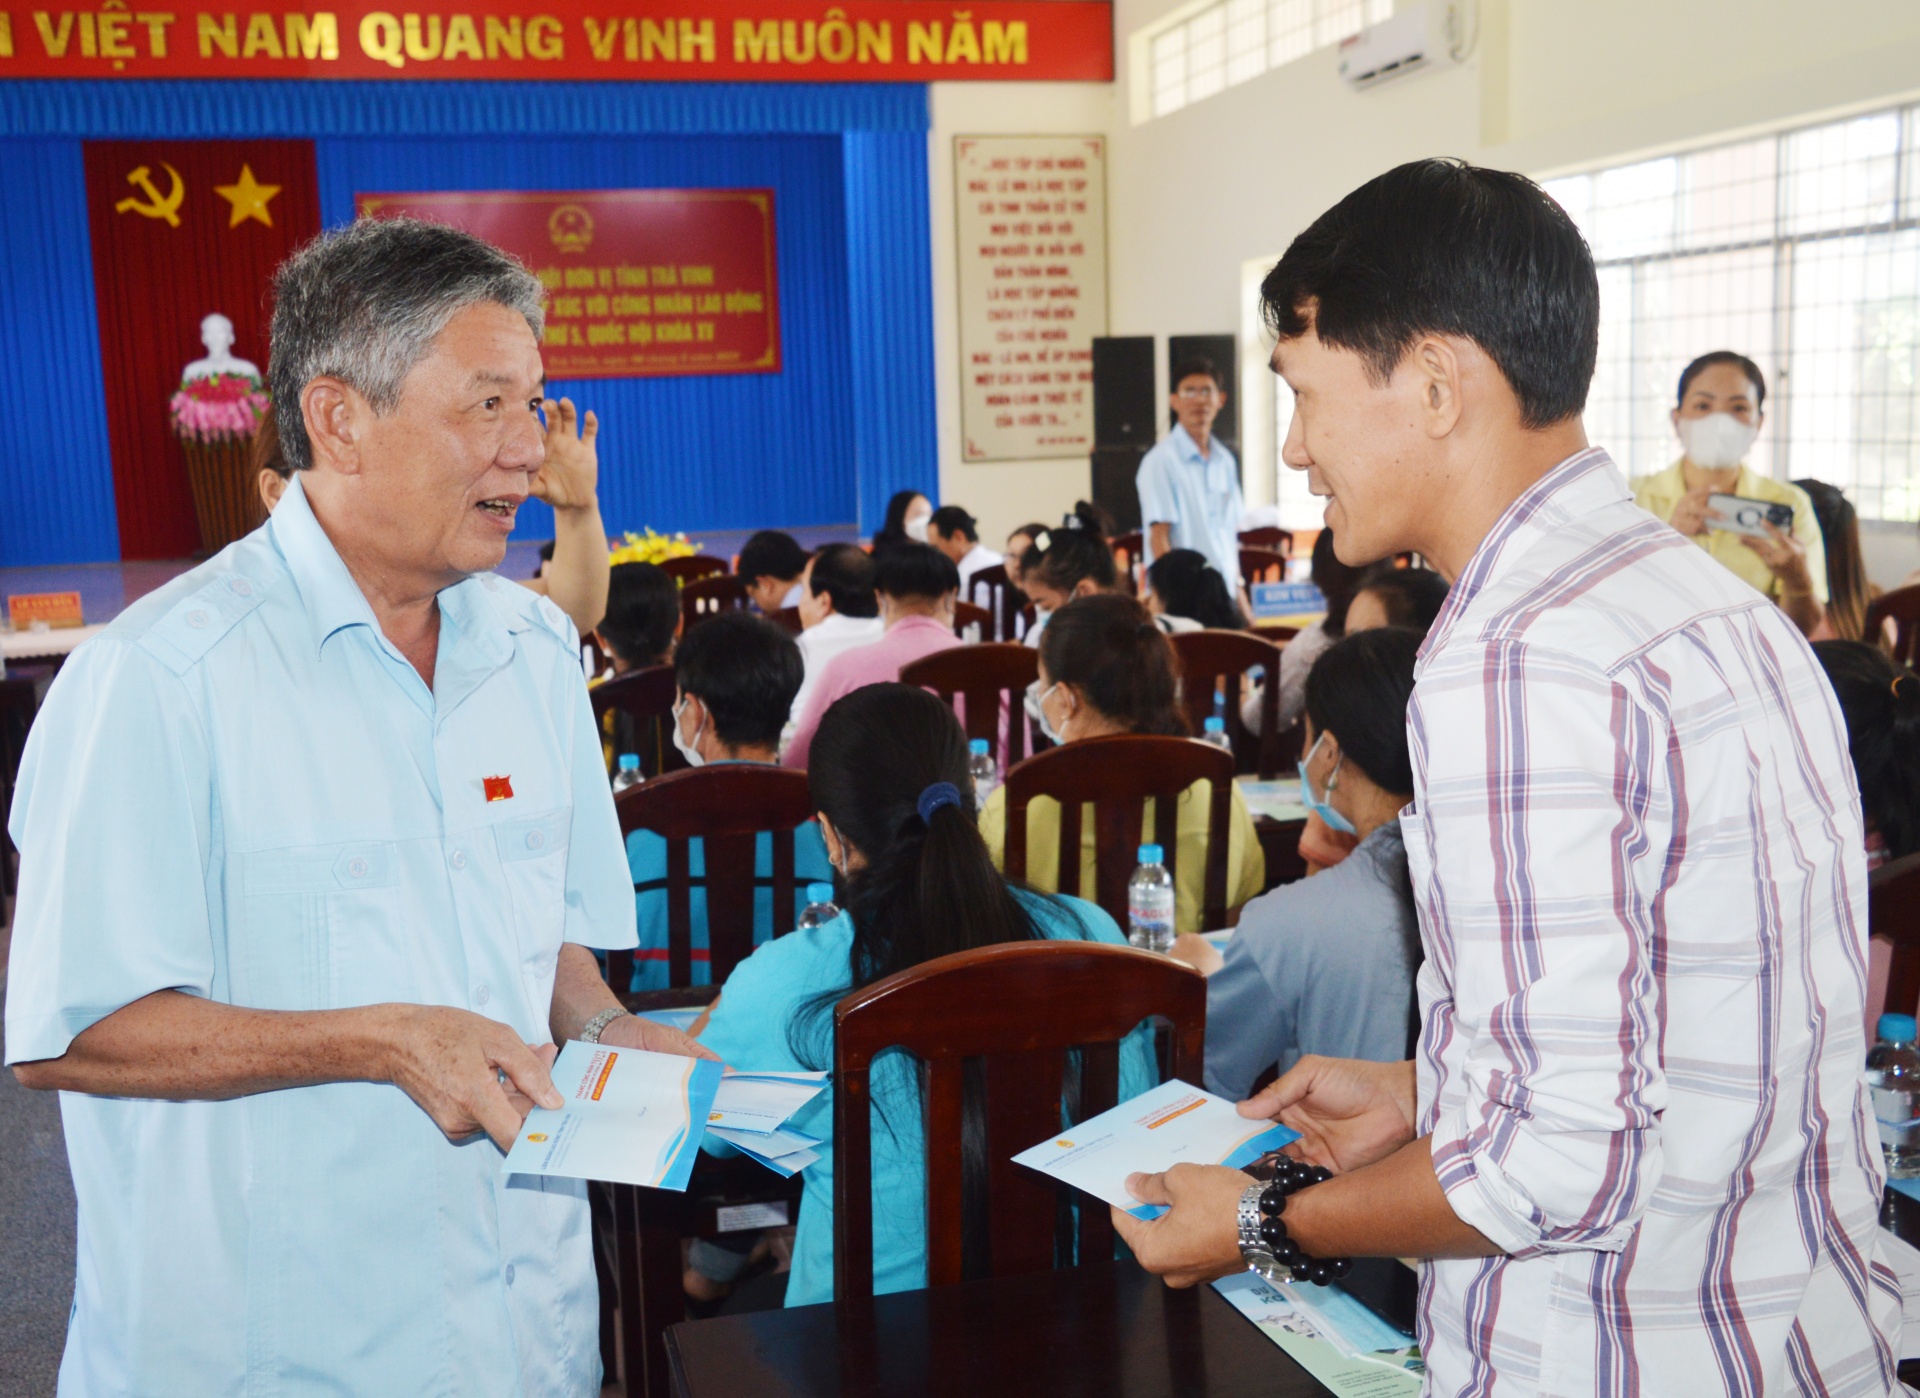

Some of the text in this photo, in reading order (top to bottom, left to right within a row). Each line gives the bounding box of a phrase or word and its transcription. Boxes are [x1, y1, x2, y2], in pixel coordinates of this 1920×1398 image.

[33, 0, 176, 71] VIỆT
[197, 12, 340, 61] NAM
[358, 12, 565, 68] QUANG
[584, 17, 716, 63] VINH
[733, 8, 892, 64] MUÔN
[906, 9, 1028, 65] NĂM
